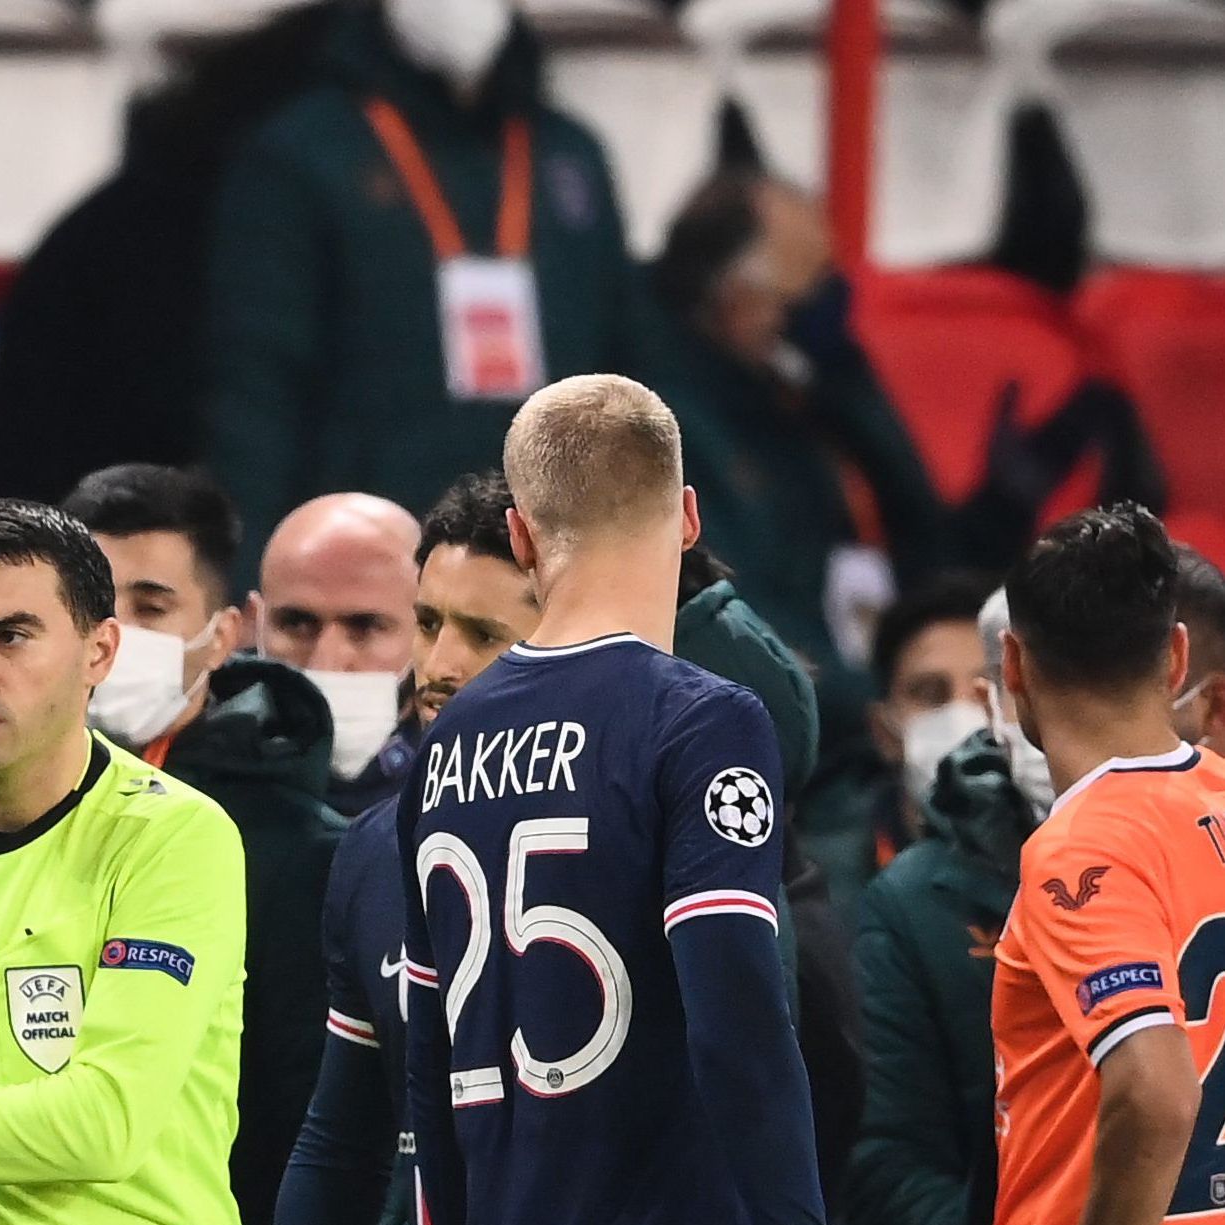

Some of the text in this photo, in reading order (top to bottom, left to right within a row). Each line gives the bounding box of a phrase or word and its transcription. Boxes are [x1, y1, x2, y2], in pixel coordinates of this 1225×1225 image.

[422, 721, 586, 813] BAKKER
[128, 946, 194, 977] RESPECT
[416, 817, 632, 1108] 25
[22, 979, 66, 999] UEFA
[1090, 968, 1160, 995] RESPECT
[26, 1010, 69, 1025] MATCH
[22, 1026, 76, 1041] OFFICIAL
